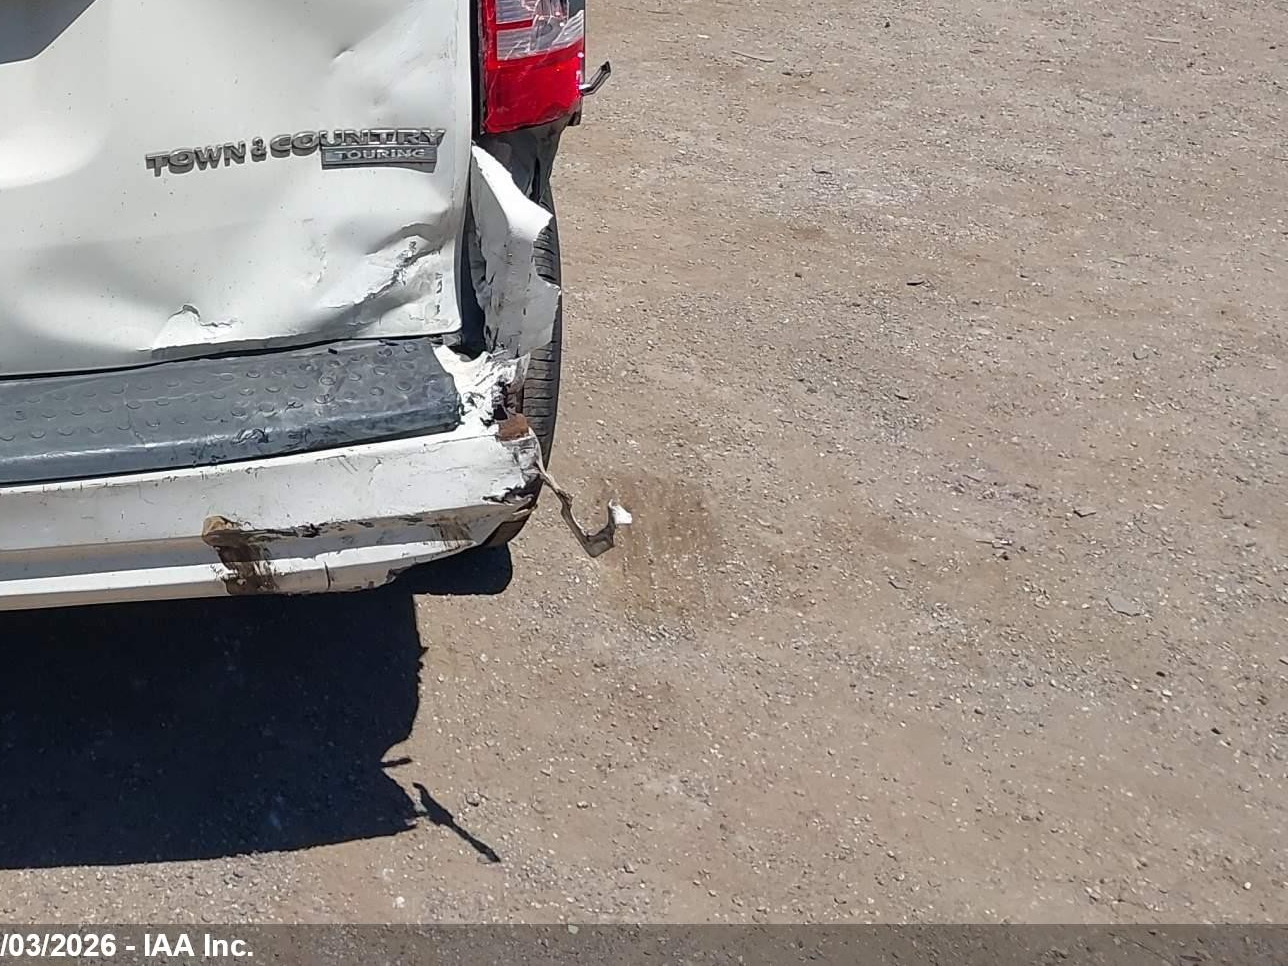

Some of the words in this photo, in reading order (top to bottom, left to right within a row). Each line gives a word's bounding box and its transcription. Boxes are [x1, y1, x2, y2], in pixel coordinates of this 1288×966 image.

[145, 140, 246, 177] TOWN
[251, 136, 267, 162] &
[270, 128, 446, 158] COUNTRY
[334, 149, 425, 160] TOURING
